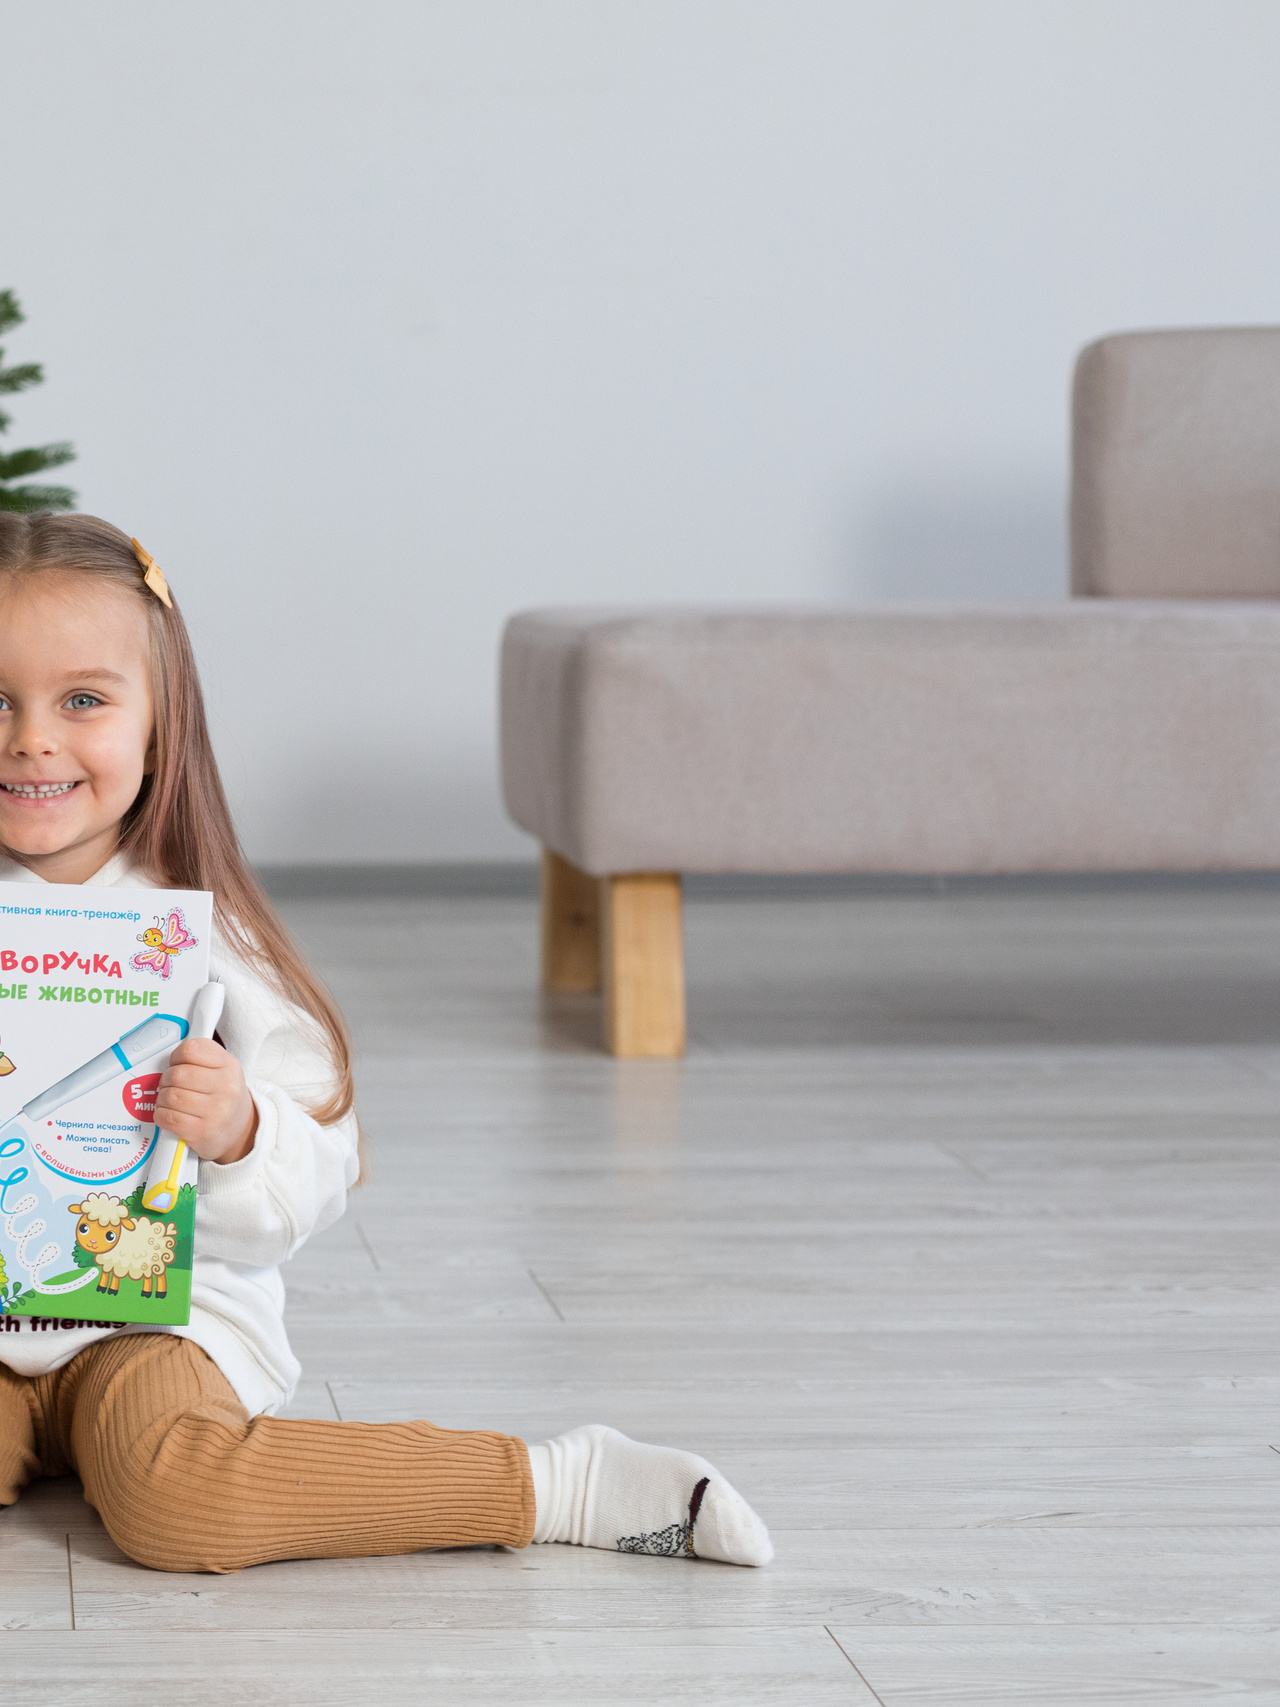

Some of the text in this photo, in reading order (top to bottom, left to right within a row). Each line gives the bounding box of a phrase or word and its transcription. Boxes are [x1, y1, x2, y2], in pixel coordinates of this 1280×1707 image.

[45, 908, 141, 923] книга-тренажёр
[38, 985, 160, 1007] ЖИВОТНЫЕ
[55, 1120, 142, 1132] Чернила исчезают!
[65, 1134, 130, 1145] Можно писать
[82, 1145, 112, 1153] снова!
[41, 1149, 105, 1178] ВОЛШЕБНЫМИ
[107, 1137, 150, 1177] ЧЕРНИЛАМИ
